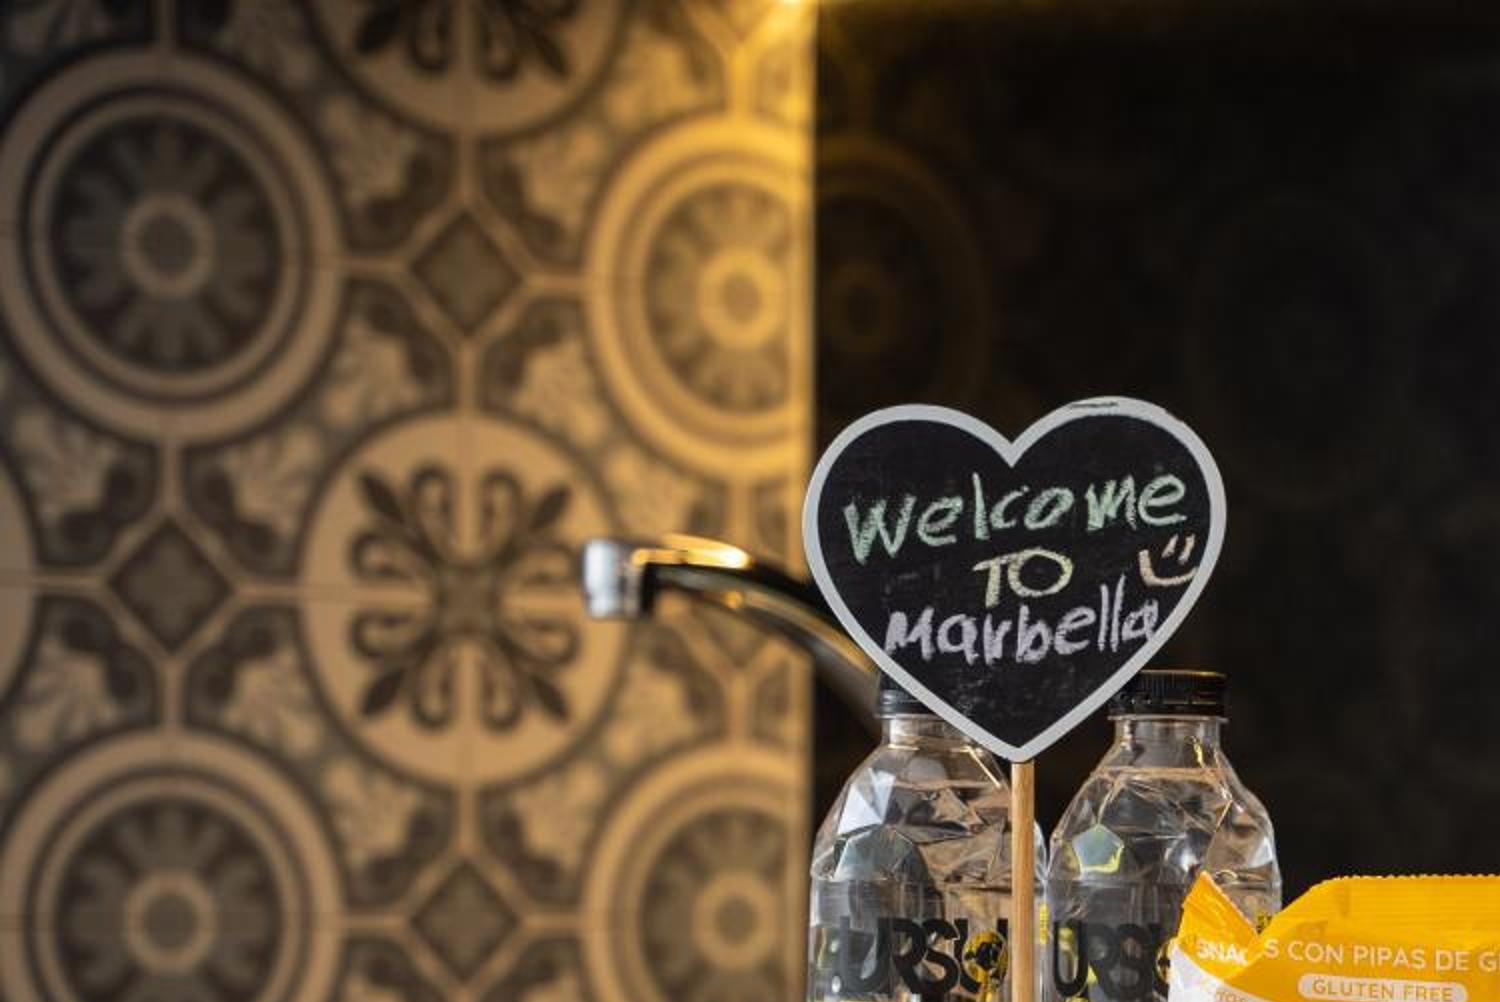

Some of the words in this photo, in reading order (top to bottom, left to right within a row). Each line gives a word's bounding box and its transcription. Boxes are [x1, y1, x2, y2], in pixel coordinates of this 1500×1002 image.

[843, 472, 1187, 565] Welcome
[973, 547, 1073, 608] TO
[884, 572, 1159, 668] Marbella
[1287, 940, 1345, 964] CON
[1353, 946, 1427, 971] PIPAS
[1435, 950, 1469, 973] DE
[1312, 978, 1395, 1000] GLUTEN
[1403, 984, 1454, 1002] FREE
